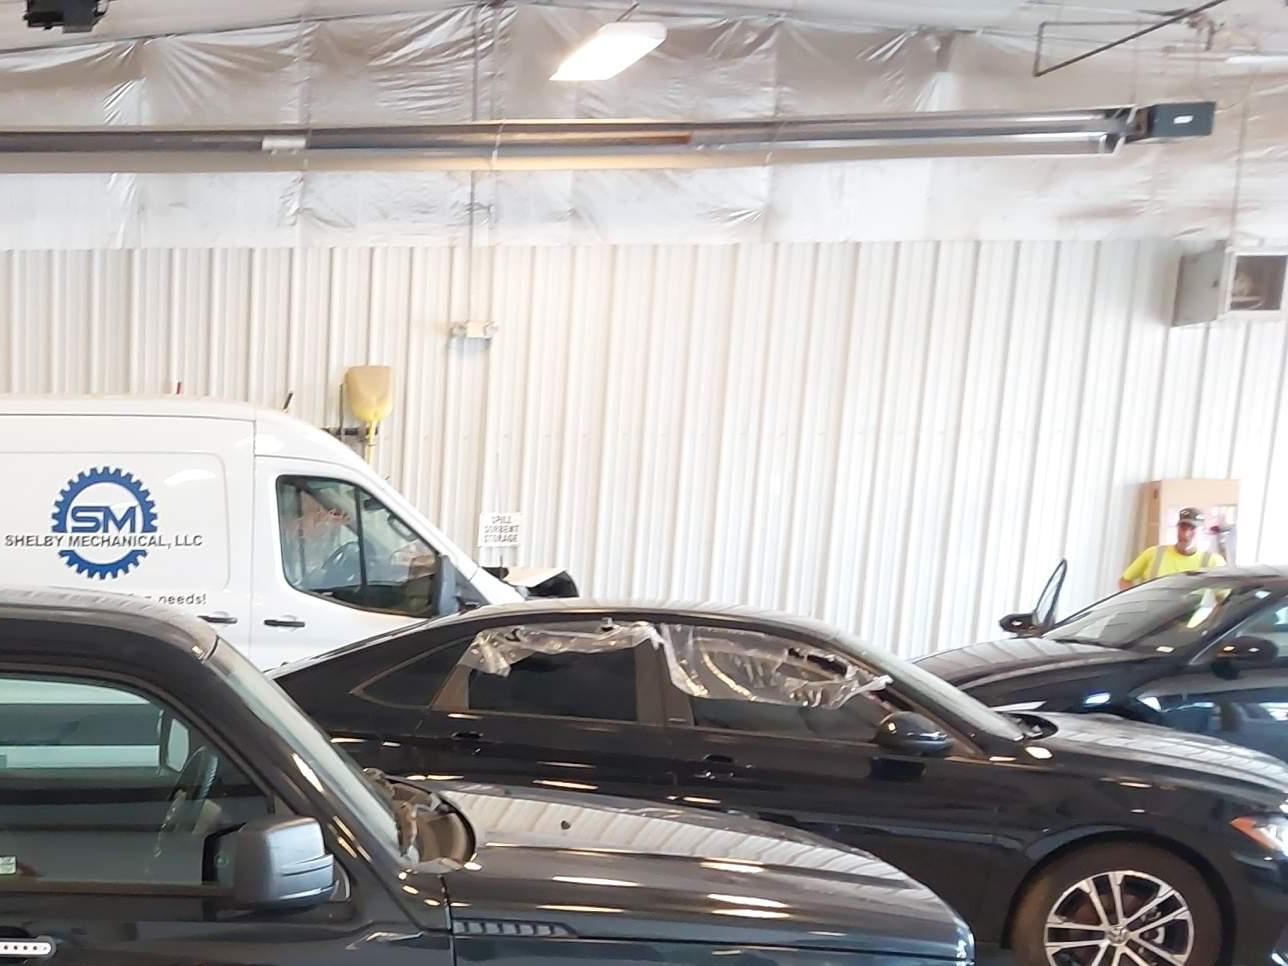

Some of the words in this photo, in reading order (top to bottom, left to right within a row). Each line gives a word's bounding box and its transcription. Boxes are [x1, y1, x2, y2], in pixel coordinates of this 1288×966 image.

[71, 506, 137, 533] SM
[4, 534, 65, 547] SHELBY
[68, 534, 171, 549] MECHANICAL,
[174, 534, 203, 546] LLC
[158, 593, 207, 605] needs!
